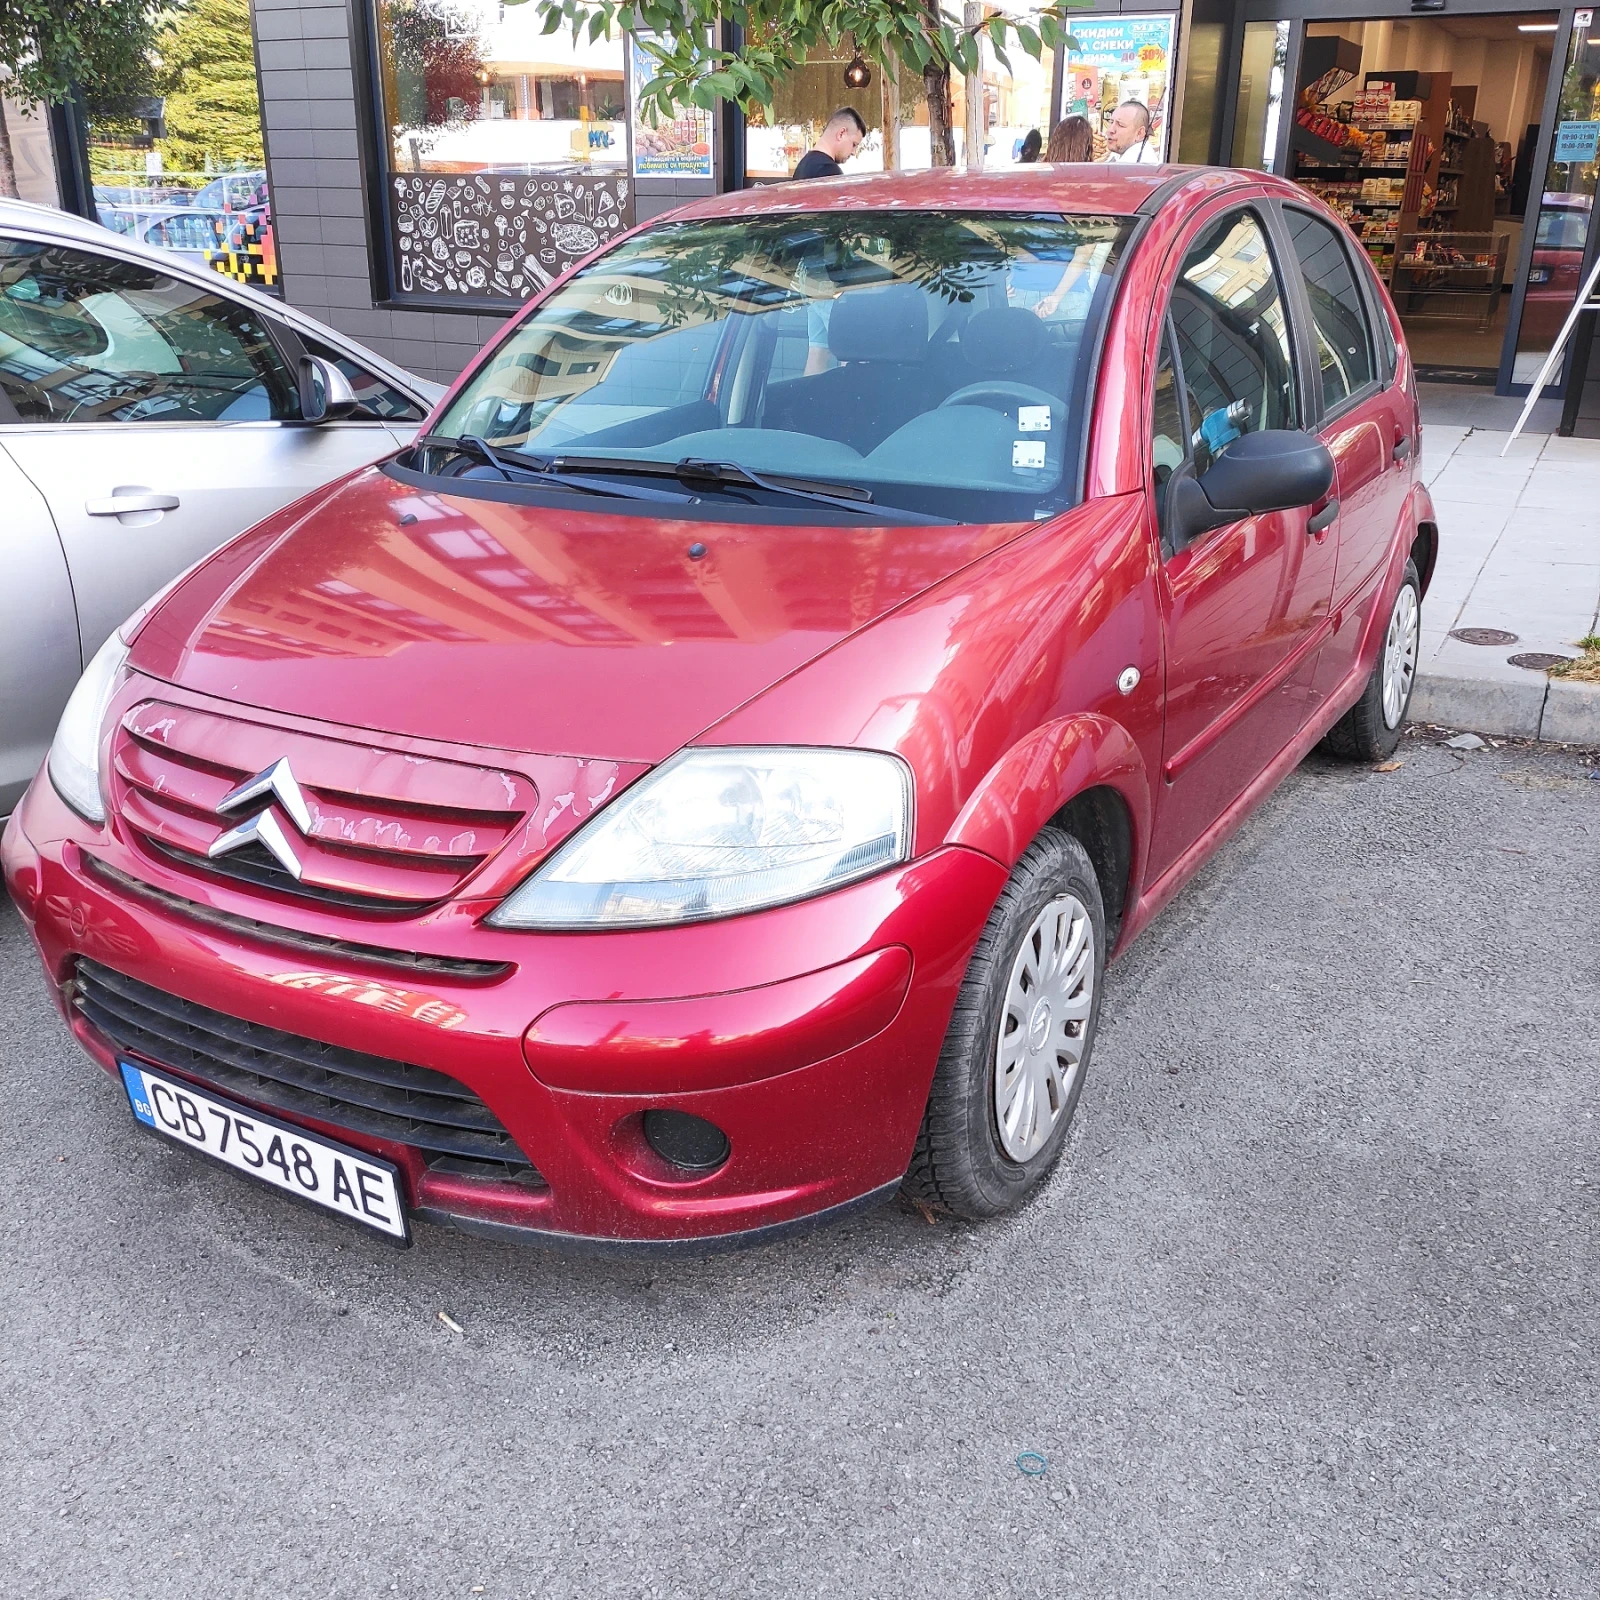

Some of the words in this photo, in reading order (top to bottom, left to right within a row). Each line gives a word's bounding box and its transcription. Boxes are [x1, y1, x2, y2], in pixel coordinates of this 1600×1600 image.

[1073, 28, 1124, 39] СКИДКИ
[1132, 23, 1168, 31] MIX
[1092, 40, 1135, 50] СНЕКИ
[1071, 55, 1078, 63] И
[1082, 53, 1117, 63] БИРА
[1138, 48, 1166, 61] -30%
[134, 1098, 152, 1117] BG
[151, 1083, 206, 1142] CB
[208, 1106, 319, 1191] 7548
[333, 1158, 392, 1224] AE
